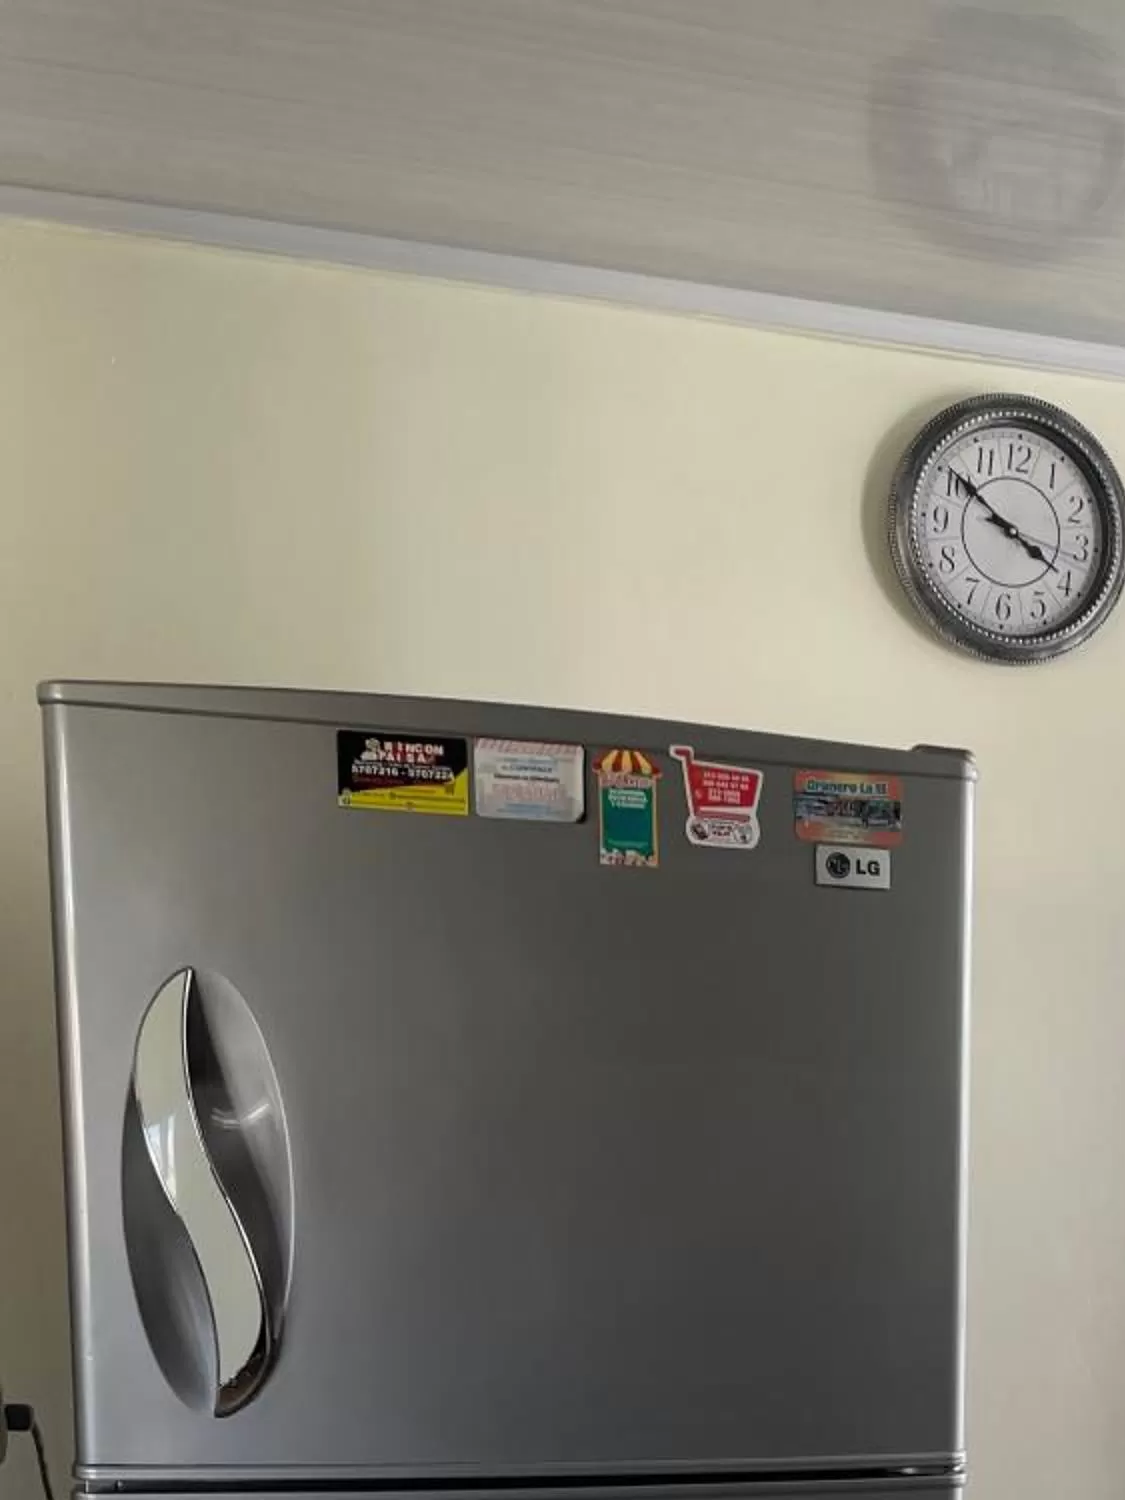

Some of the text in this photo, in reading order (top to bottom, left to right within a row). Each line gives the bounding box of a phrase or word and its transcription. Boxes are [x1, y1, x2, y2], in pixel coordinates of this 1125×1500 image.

[977, 447, 994, 476] 11
[1007, 443, 1031, 474] 12
[1049, 463, 1057, 489] 1
[933, 506, 949, 533] 9
[1068, 496, 1085, 524] 2
[939, 545, 955, 574] 8
[1073, 535, 1089, 562] 3
[965, 578, 980, 605] 7
[1056, 570, 1072, 596] 4
[995, 594, 1011, 621] 6
[1030, 591, 1047, 620] 5
[856, 859, 880, 876] LG
